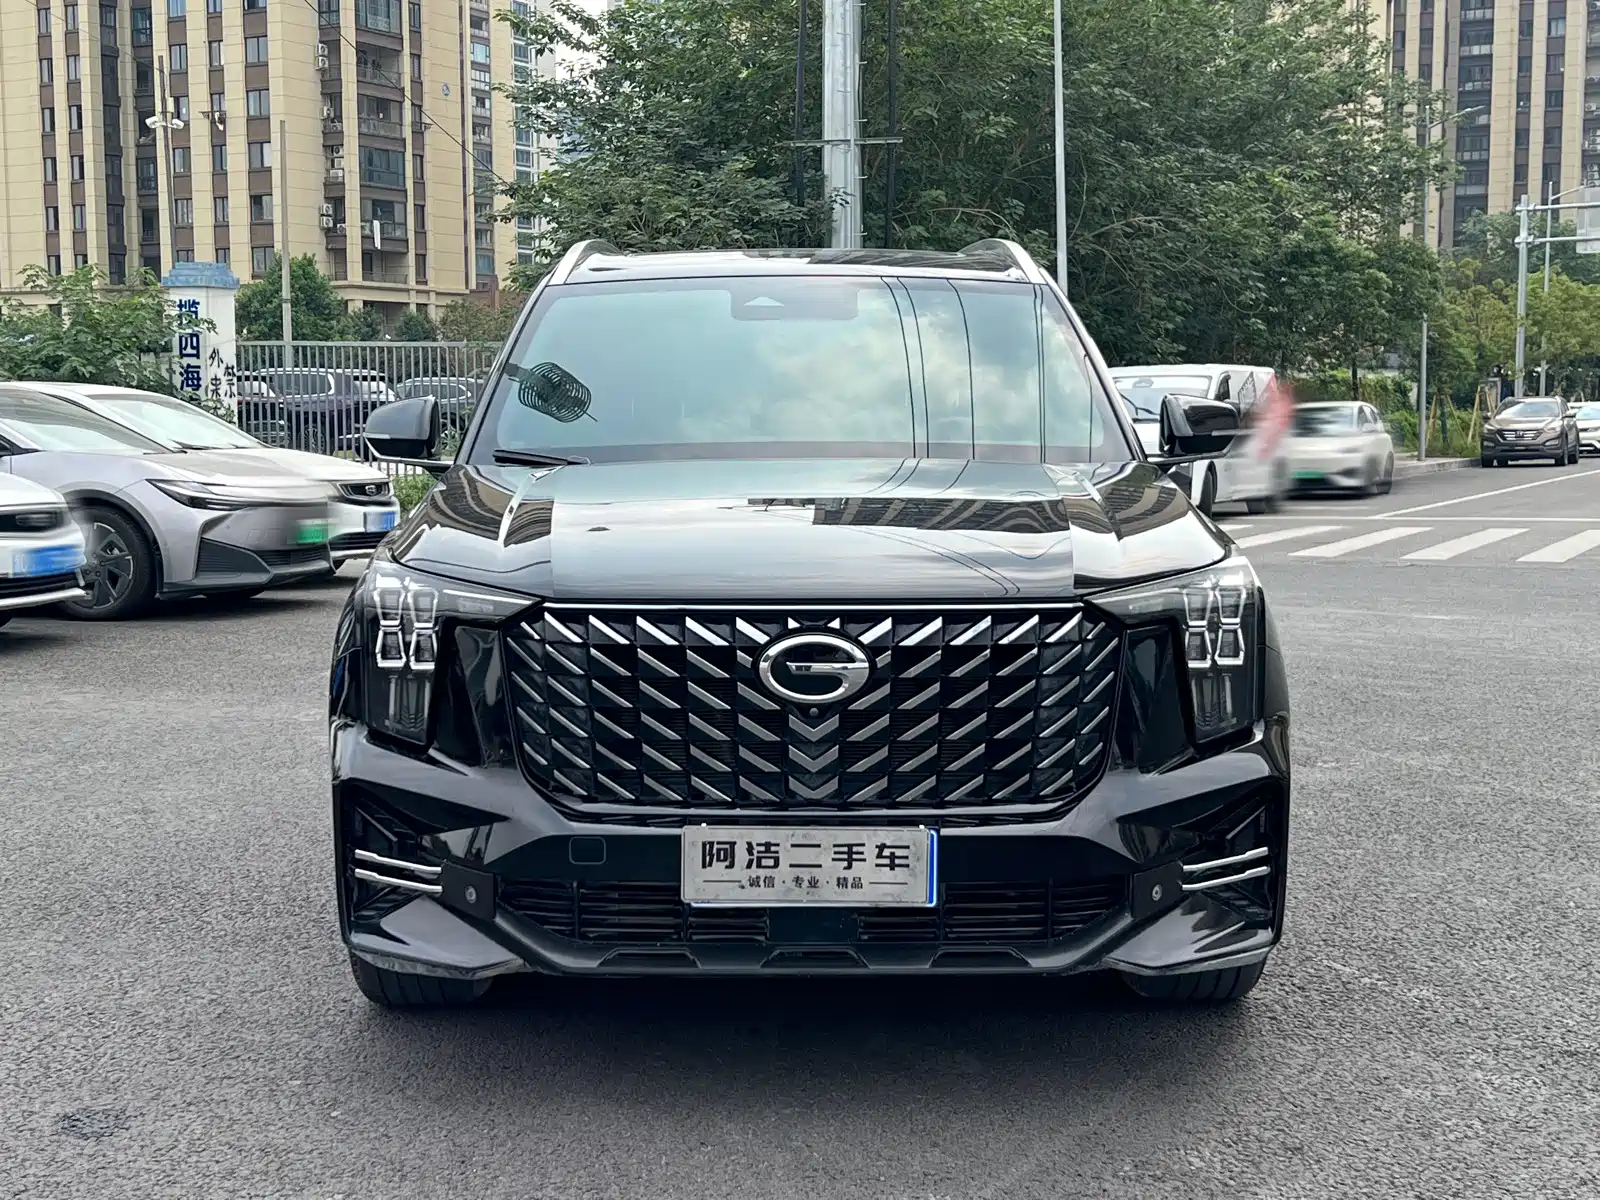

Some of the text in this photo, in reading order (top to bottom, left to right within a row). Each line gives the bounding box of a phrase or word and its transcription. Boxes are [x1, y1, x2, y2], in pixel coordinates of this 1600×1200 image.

[701, 841, 911, 871] 阿洁二手车
